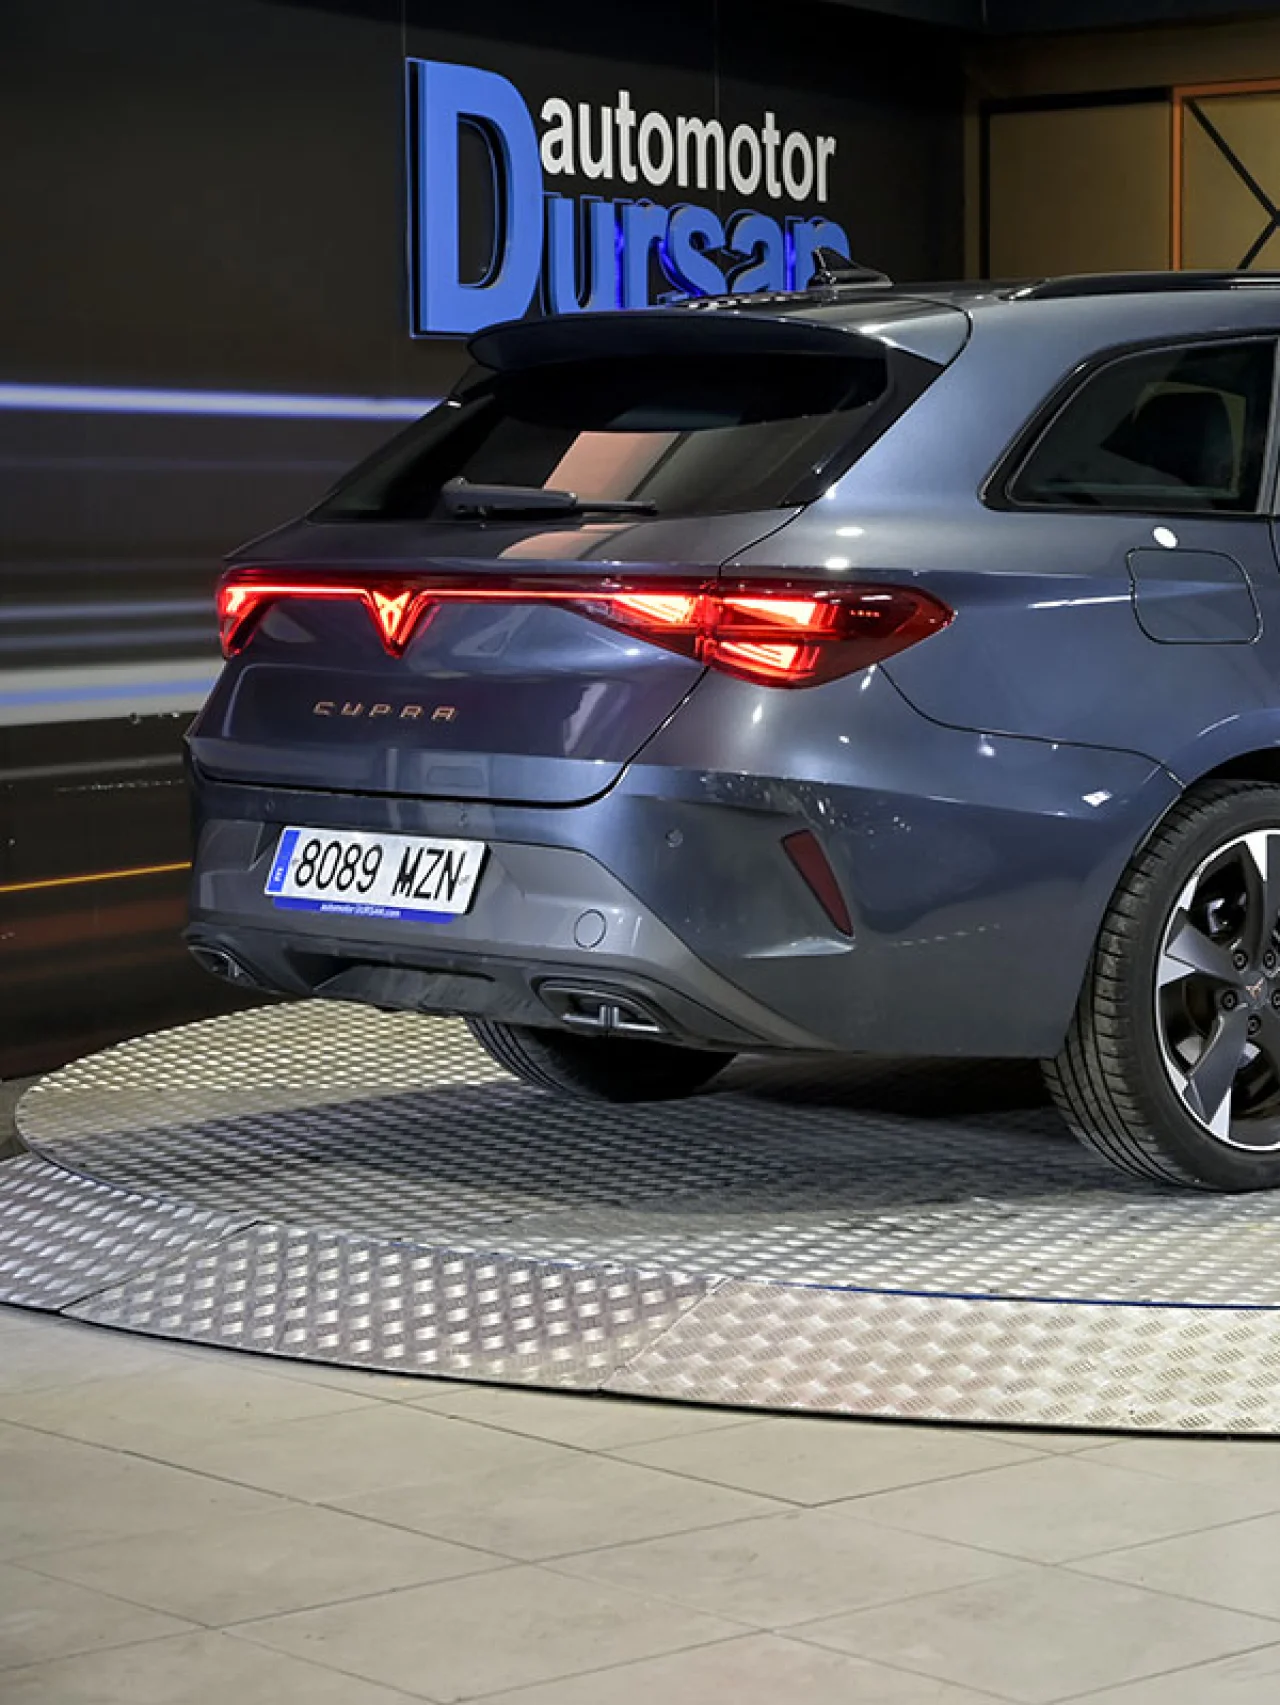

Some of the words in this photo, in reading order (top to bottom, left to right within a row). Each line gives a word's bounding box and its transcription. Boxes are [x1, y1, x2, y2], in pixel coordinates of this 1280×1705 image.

[540, 89, 837, 202] automotor
[312, 701, 457, 721] CUPRA
[294, 838, 384, 893] 8089
[391, 845, 466, 902] MZN
